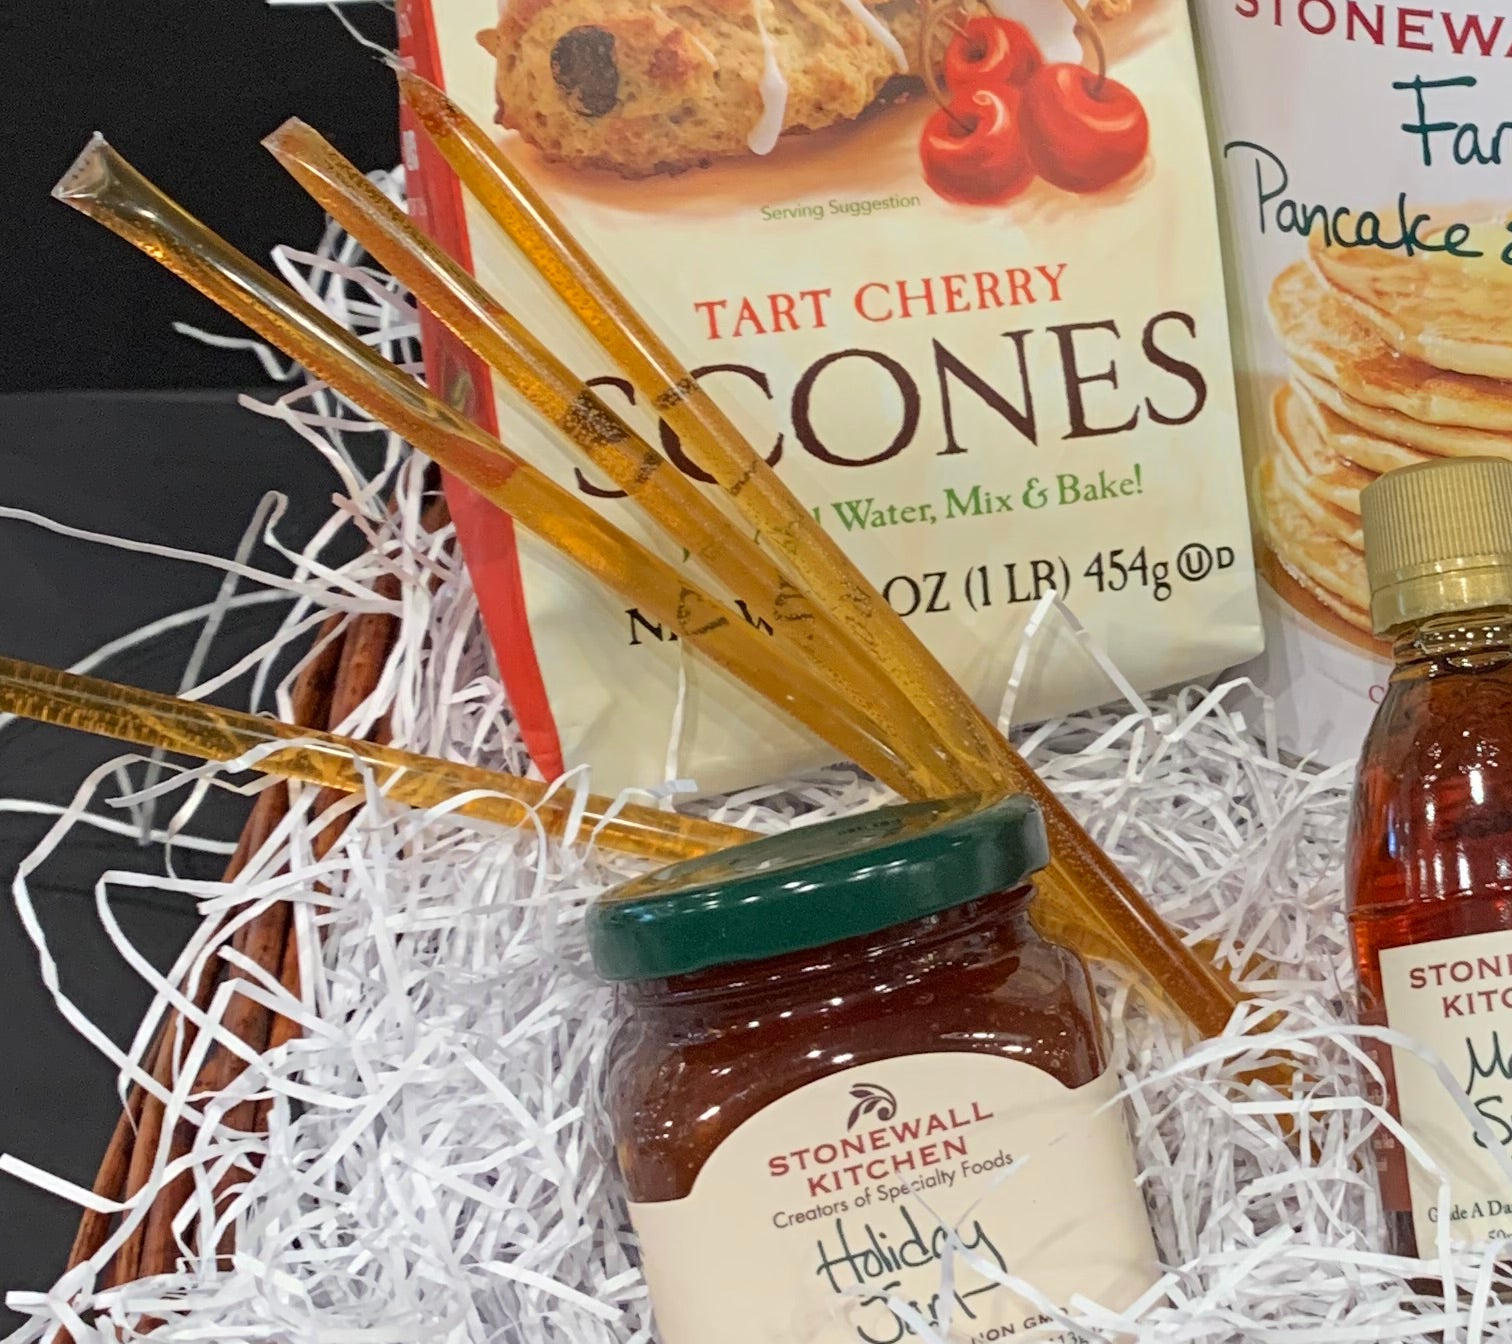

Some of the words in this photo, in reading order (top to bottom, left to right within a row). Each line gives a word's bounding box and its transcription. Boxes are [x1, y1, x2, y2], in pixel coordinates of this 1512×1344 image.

[760, 203, 825, 222] Serving
[828, 193, 921, 217] Suggestion
[1223, 140, 1484, 259] Pancake
[694, 288, 832, 341] TART
[853, 263, 1069, 324] CHERRY
[831, 497, 937, 533] Water,
[943, 485, 1015, 520] Mix
[1022, 476, 1048, 510] &
[1056, 463, 1144, 506] Bake!
[883, 571, 951, 617] OZ
[768, 1101, 995, 1178] STONEWALL
[806, 1135, 969, 1199] KITCHEN
[772, 1197, 849, 1230] Creators
[855, 1186, 873, 1208] of
[877, 1166, 957, 1203] Specialty
[960, 1149, 1015, 1179] Foods
[1428, 1204, 1468, 1223] Gde
[1471, 1202, 1485, 1219] A
